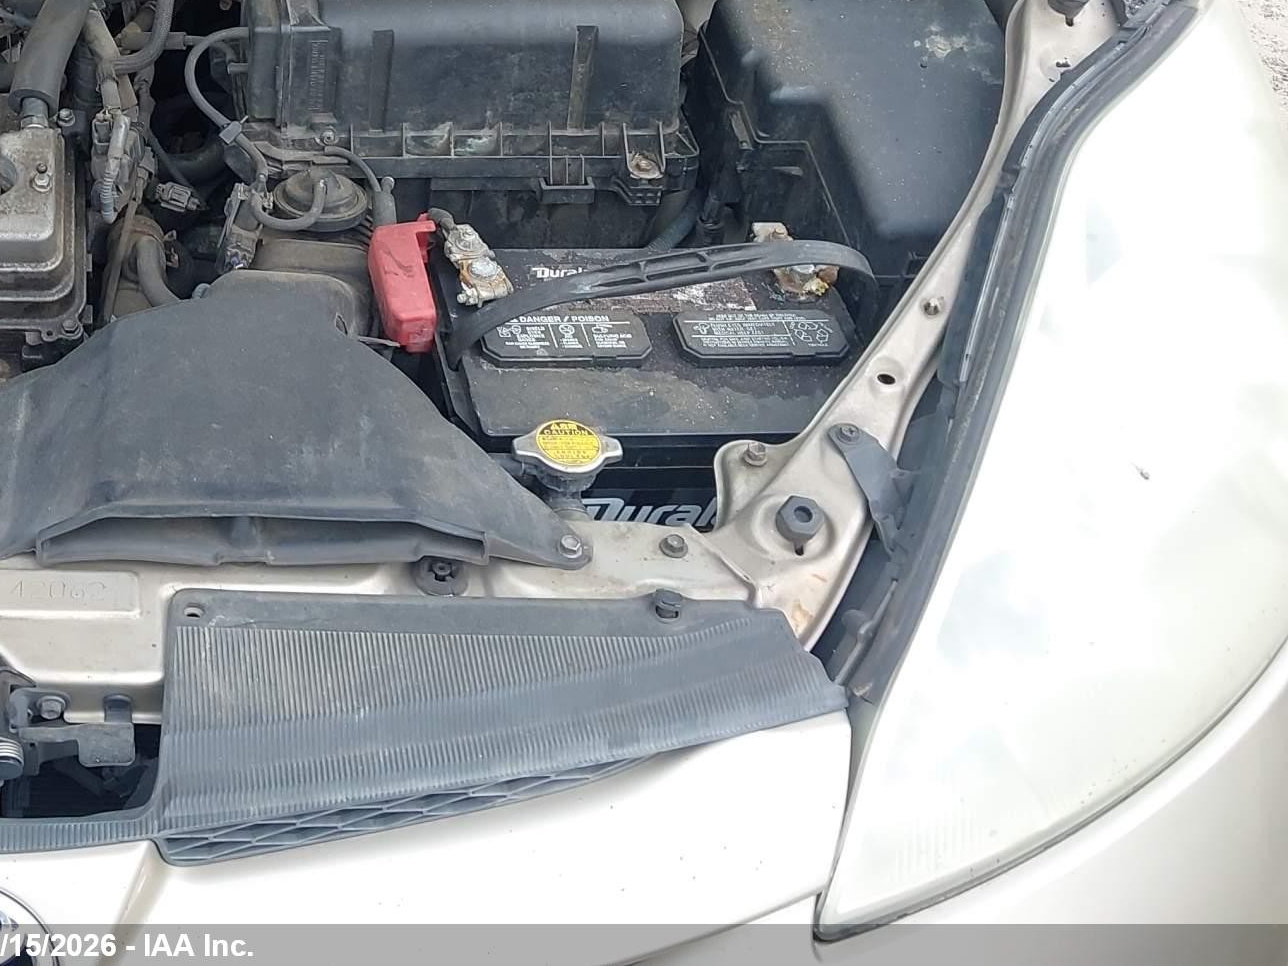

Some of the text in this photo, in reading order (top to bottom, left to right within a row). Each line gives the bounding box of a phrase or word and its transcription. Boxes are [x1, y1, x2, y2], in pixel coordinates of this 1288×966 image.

[532, 267, 589, 278] Dural
[520, 315, 561, 323] DANGER
[571, 315, 610, 323] POISON
[581, 498, 717, 527] Dural
